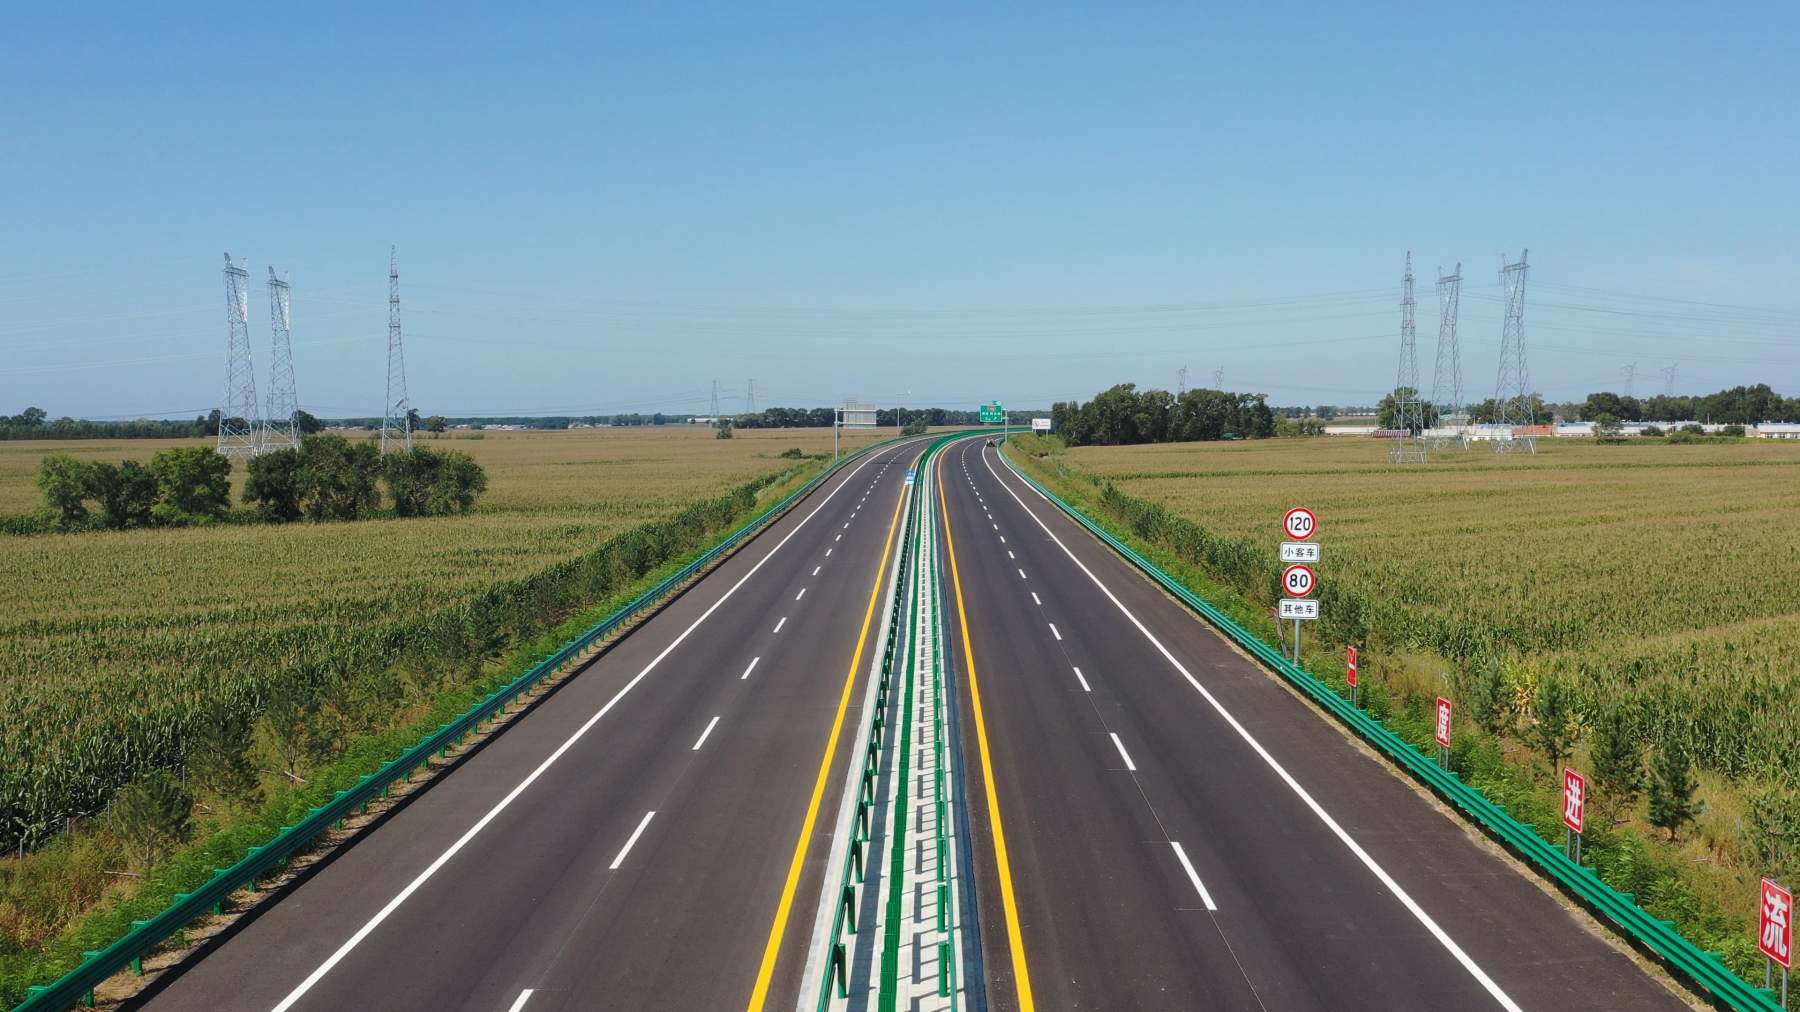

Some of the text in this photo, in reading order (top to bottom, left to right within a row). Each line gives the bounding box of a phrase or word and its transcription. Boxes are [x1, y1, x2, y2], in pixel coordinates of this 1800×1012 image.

[1290, 516, 1311, 531] 120
[1284, 547, 1315, 558] 小客车
[1289, 573, 1308, 588] 80
[1283, 604, 1314, 614] 其他车
[1565, 776, 1581, 826] 进
[1763, 890, 1787, 957] 流
